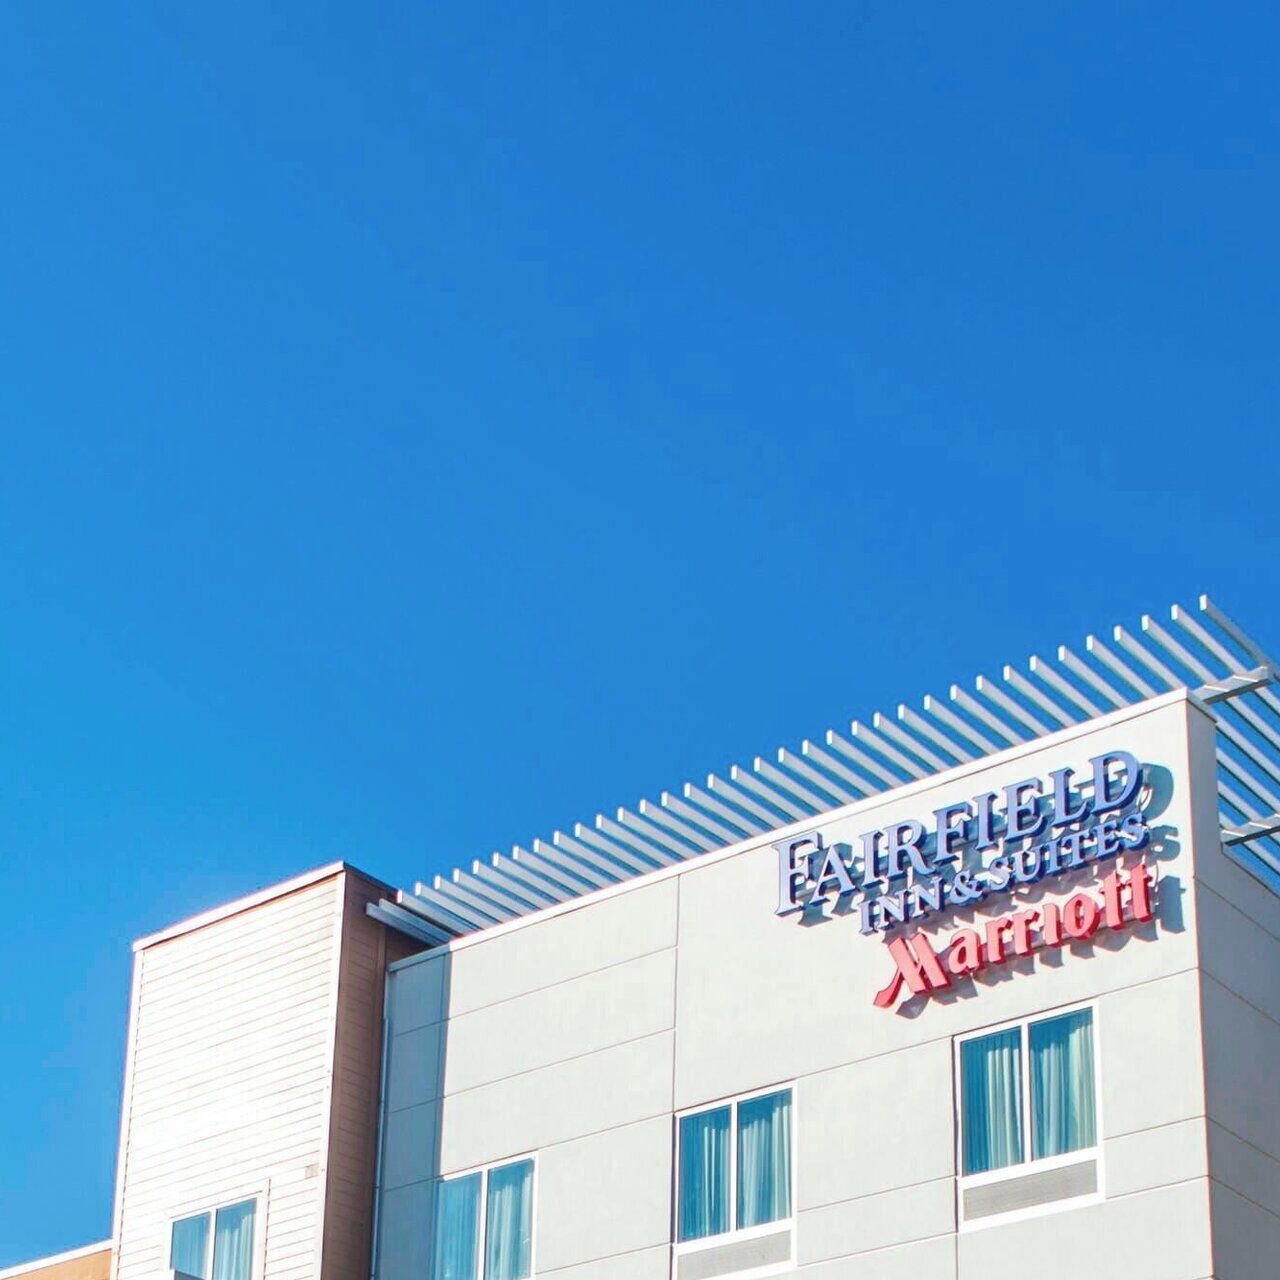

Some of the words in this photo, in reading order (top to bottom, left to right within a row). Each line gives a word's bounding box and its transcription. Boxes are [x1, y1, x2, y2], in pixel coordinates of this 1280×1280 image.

[773, 750, 1145, 917] FAIRFIELD
[858, 876, 946, 936] INN
[988, 812, 1151, 891] SUITES
[873, 862, 1154, 1009] Marriott
